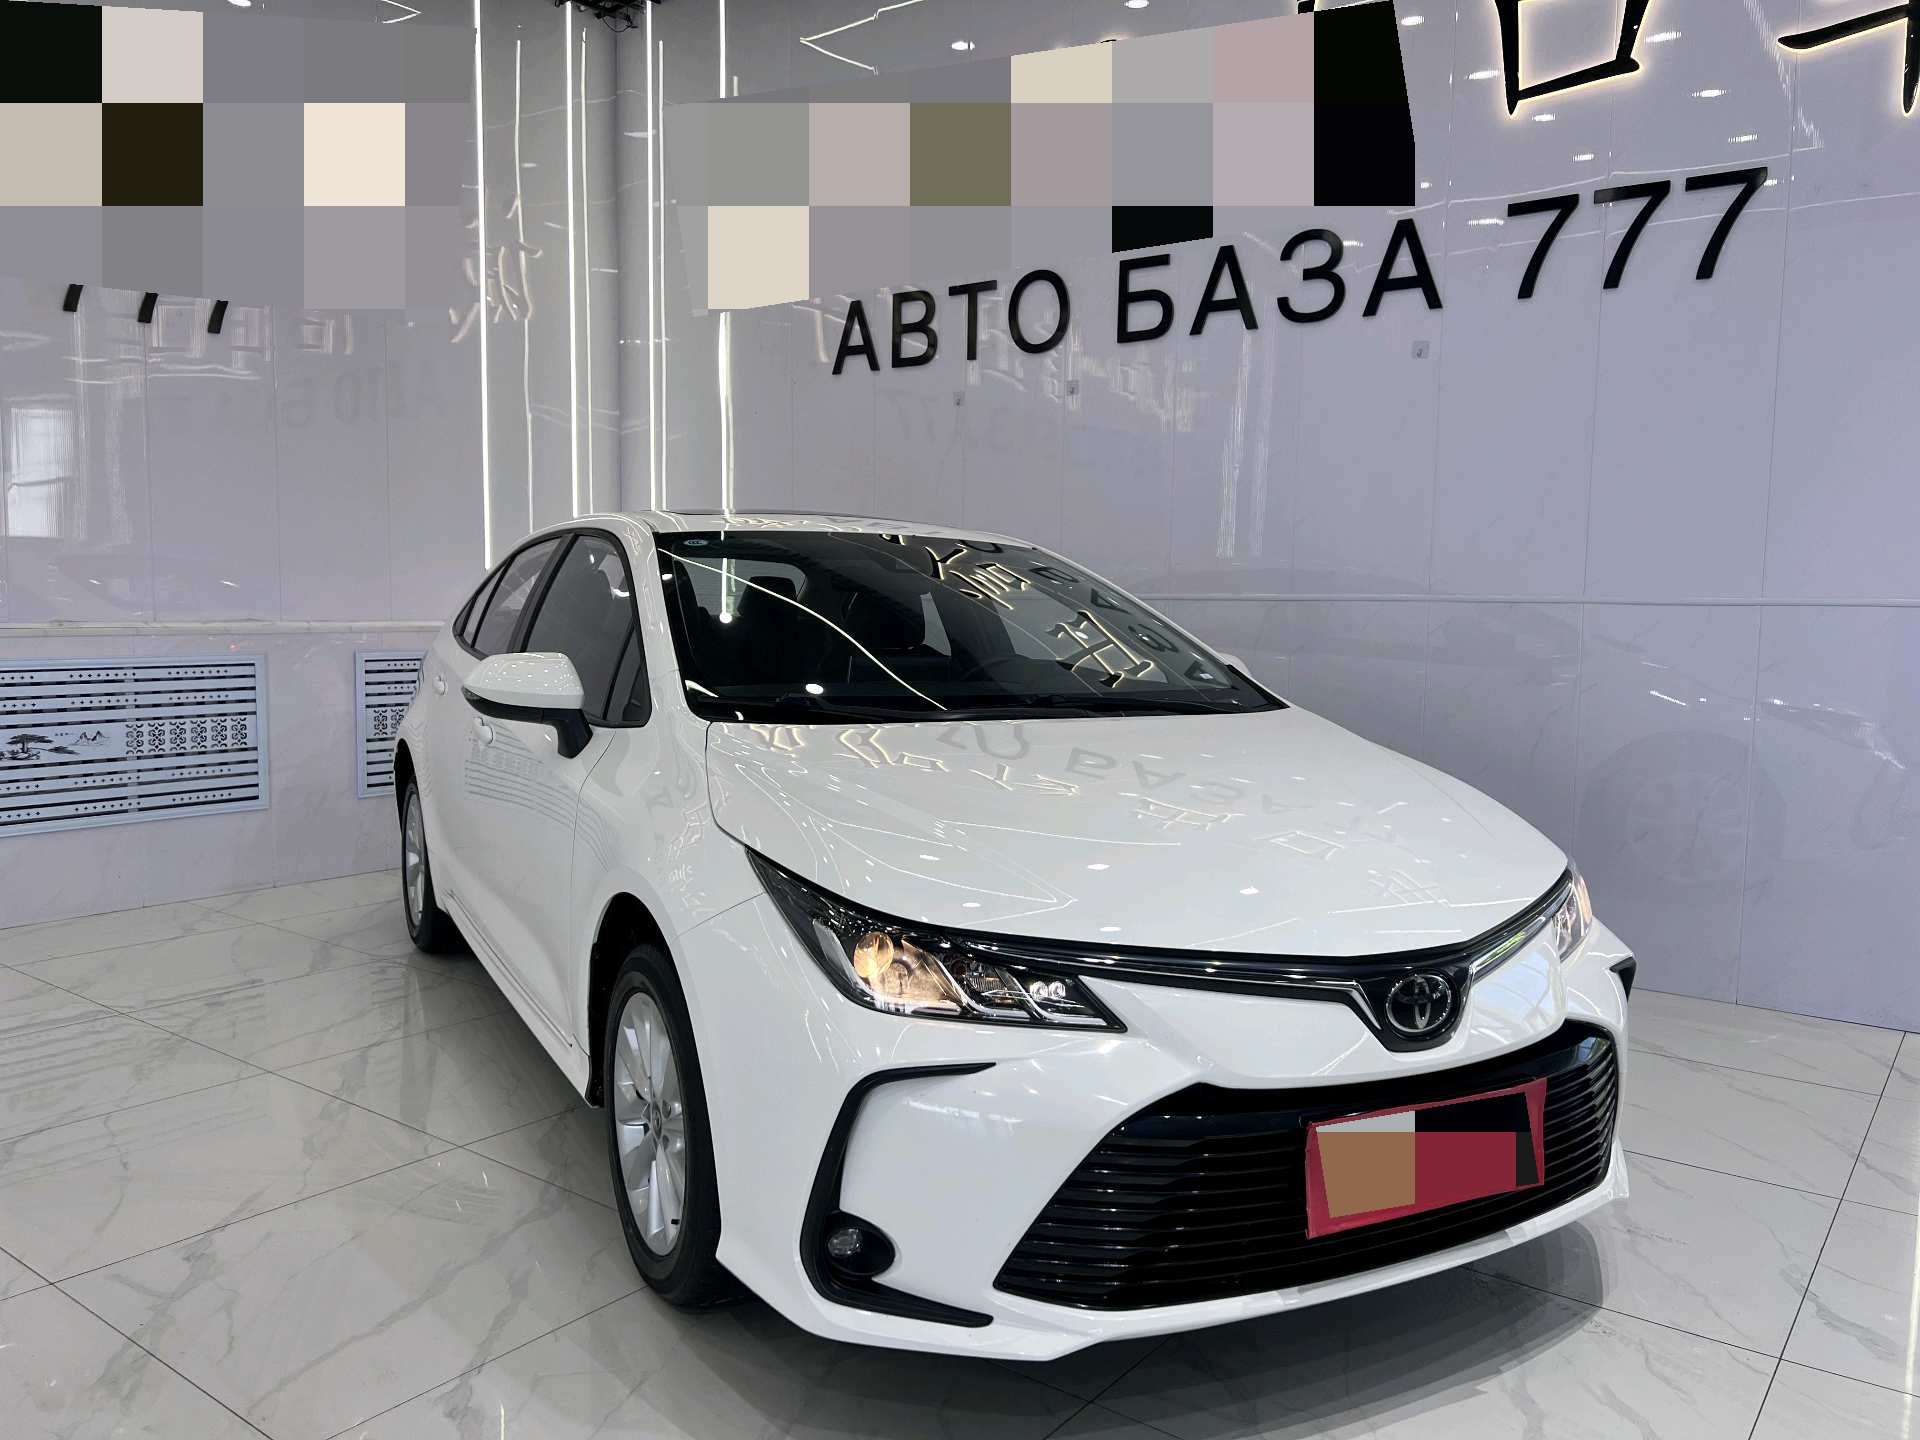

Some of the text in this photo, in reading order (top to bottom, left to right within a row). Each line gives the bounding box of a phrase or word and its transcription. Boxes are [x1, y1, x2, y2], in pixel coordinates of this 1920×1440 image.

[832, 167, 1768, 375] АВТО БАЗА 777
